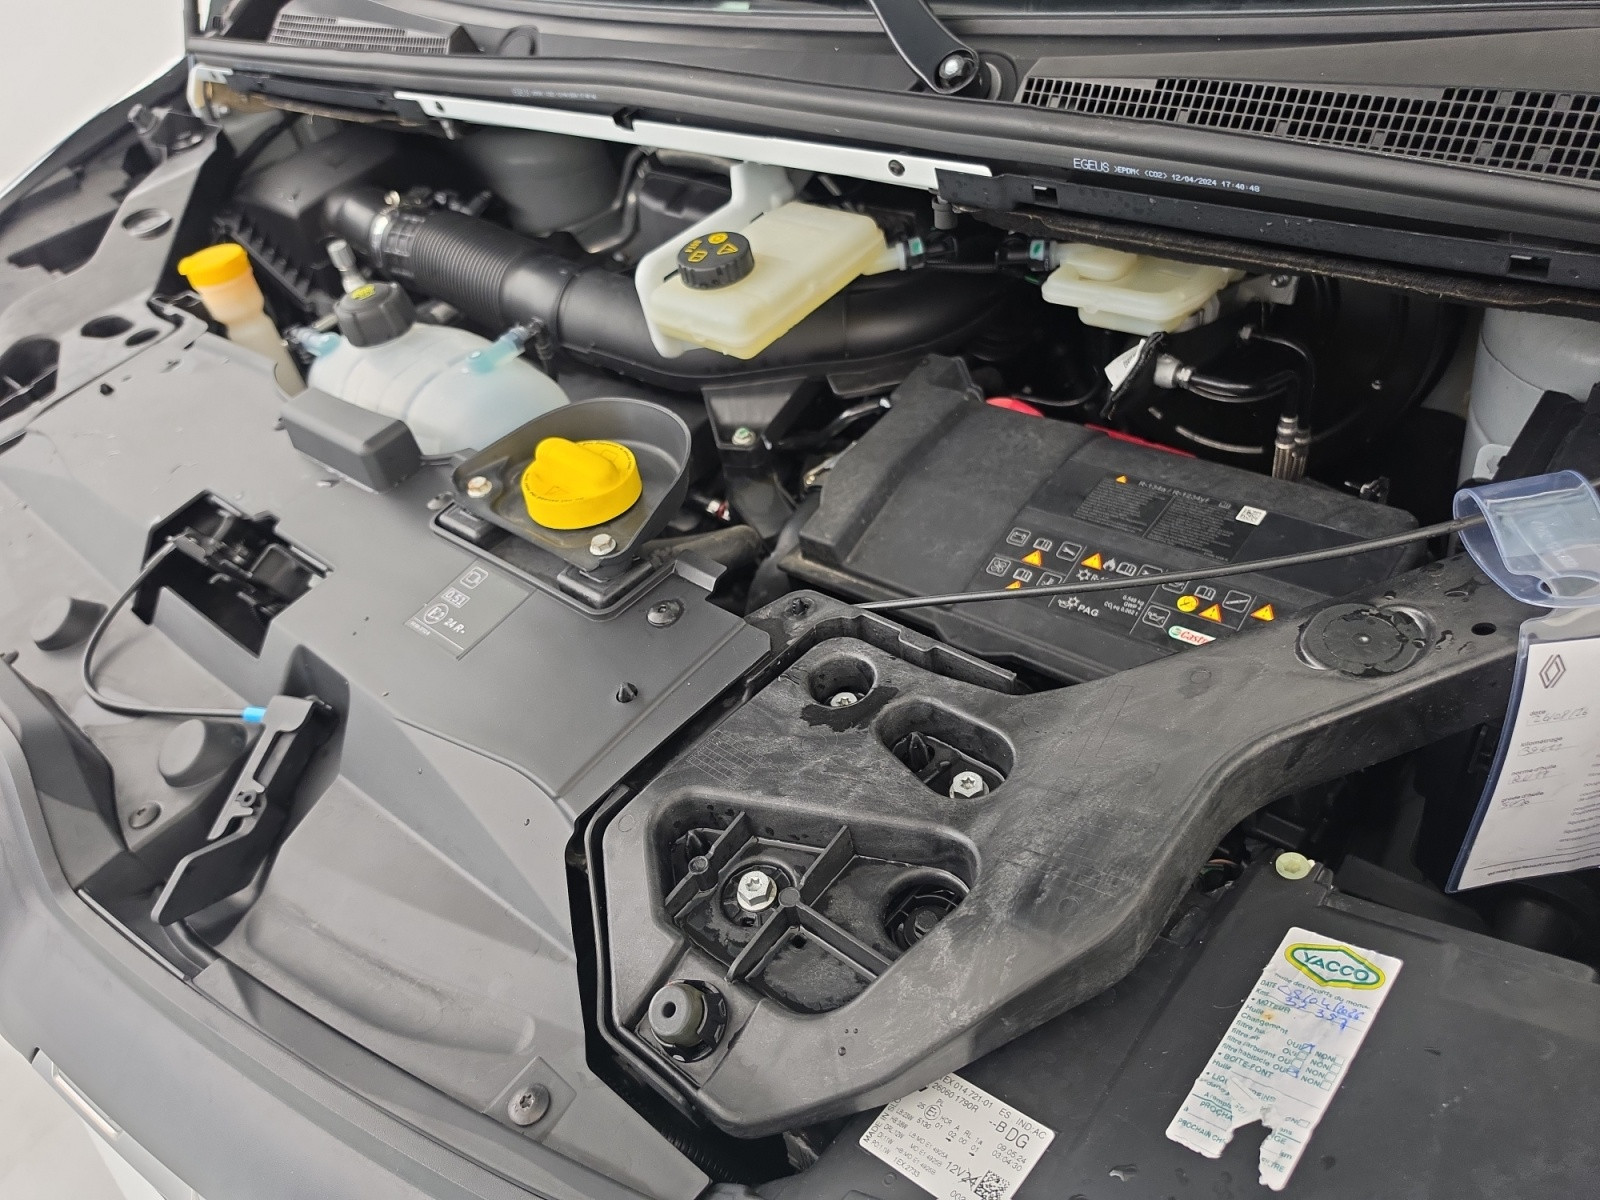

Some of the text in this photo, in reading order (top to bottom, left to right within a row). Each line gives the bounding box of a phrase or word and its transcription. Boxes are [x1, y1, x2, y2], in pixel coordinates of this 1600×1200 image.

[1073, 158, 1110, 173] EGEUS
[1172, 174, 1216, 186] 12/04/2024
[1222, 181, 1260, 192] 17:40:48
[1078, 604, 1100, 617] PAG
[1303, 952, 1369, 981] YACCO
[1260, 979, 1277, 988] DATE
[954, 1081, 992, 1109] 014.721-01
[998, 1108, 1011, 1119] ES
[916, 1117, 931, 1129] 5130
[932, 1081, 954, 1098] 26060
[954, 1094, 977, 1113] 1790R
[1005, 1126, 1029, 1149] DG
[940, 1115, 951, 1125] HCR
[863, 1120, 881, 1142] MADE
